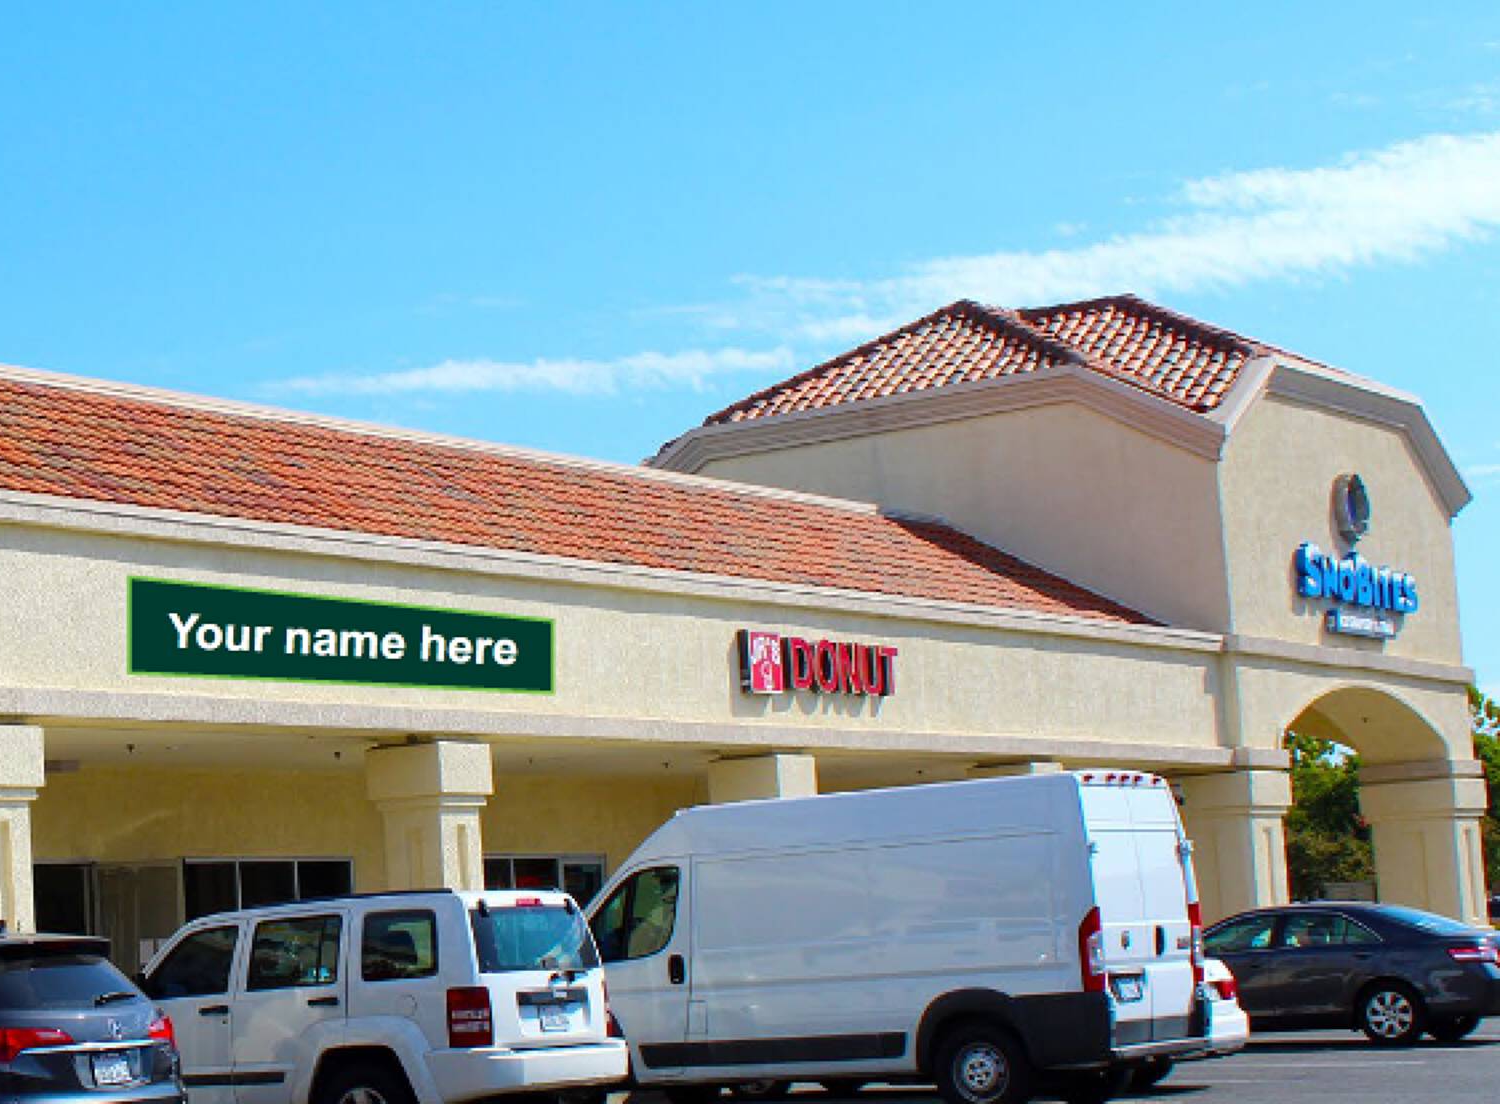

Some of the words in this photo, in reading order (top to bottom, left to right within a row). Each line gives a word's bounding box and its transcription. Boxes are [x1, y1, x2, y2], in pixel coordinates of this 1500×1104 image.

[168, 612, 274, 652] Your
[284, 626, 407, 660] name
[419, 624, 519, 666] here
[789, 636, 899, 697] DONUT
